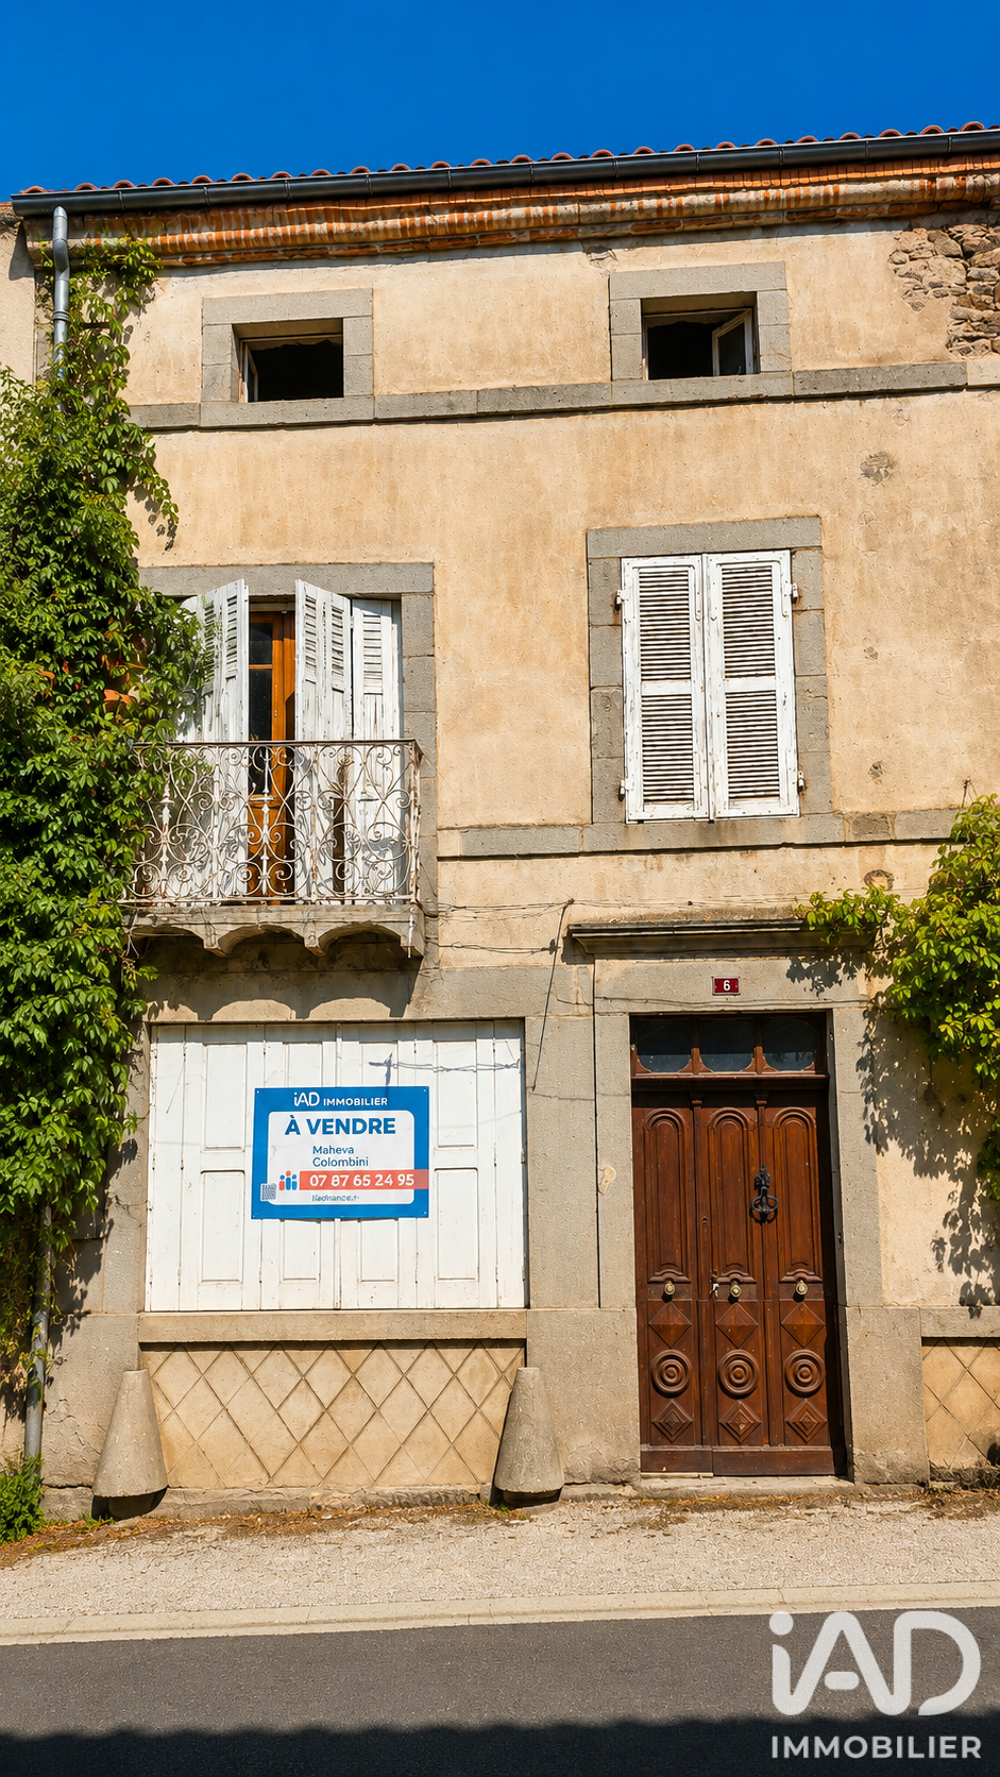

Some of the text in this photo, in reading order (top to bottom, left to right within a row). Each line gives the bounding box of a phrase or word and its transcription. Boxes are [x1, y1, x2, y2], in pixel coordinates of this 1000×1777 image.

[723, 980, 731, 991] 6
[323, 1097, 388, 1106] IMMOBILIER
[285, 1115, 396, 1135] À VENDRE
[312, 1145, 354, 1155] Maheva
[312, 1156, 369, 1167] Colombini
[309, 1174, 415, 1187] 07 87 65 24 95
